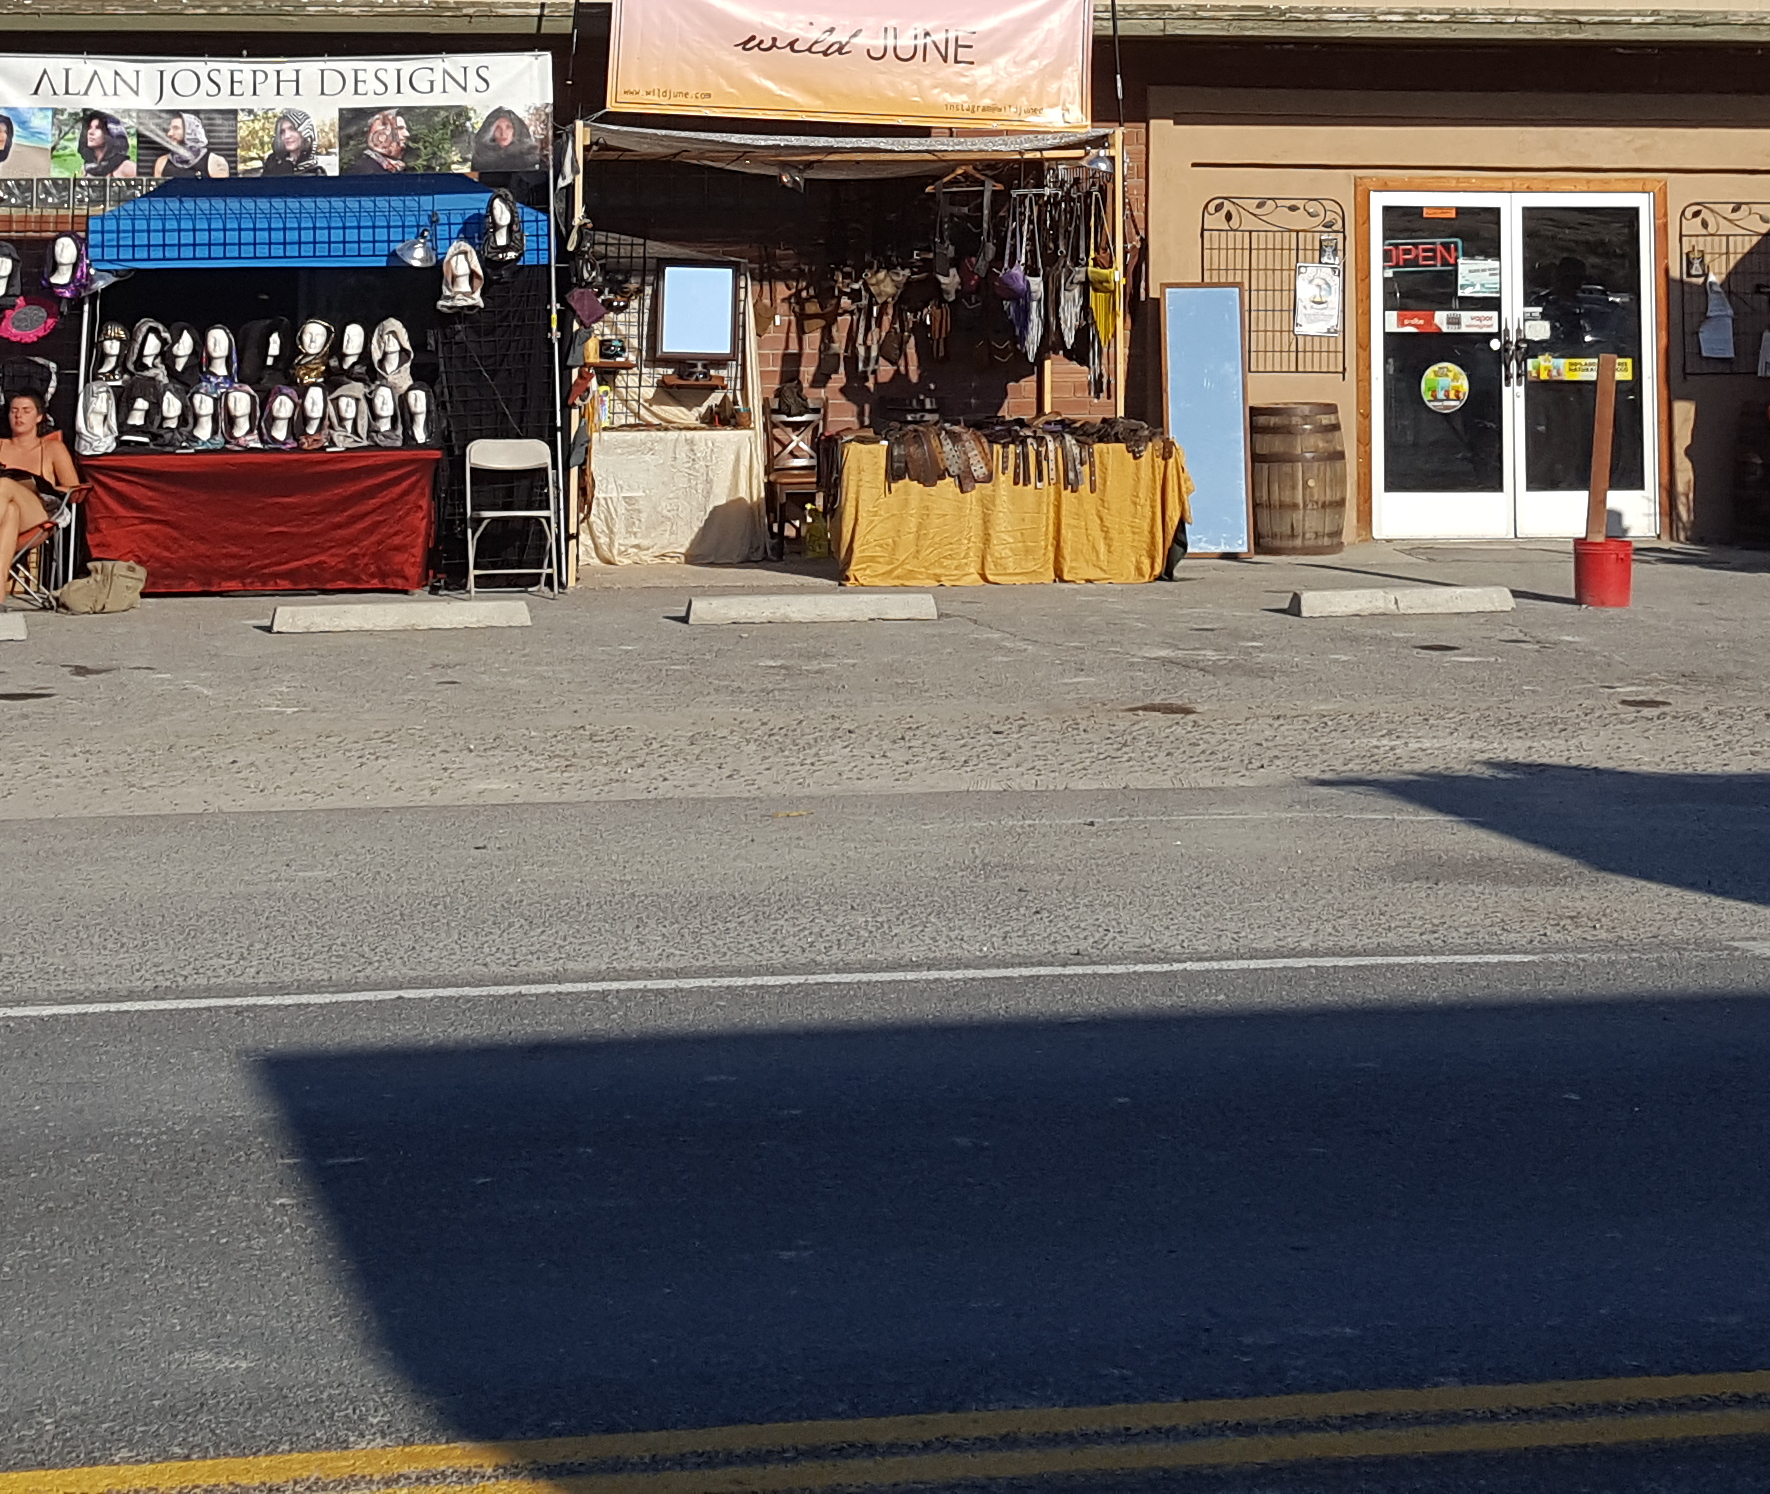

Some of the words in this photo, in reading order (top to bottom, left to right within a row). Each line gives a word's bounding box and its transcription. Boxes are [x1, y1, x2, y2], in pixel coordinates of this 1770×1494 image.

[733, 22, 864, 57] wild
[866, 26, 977, 66] JUNE
[29, 67, 141, 97] ALAN
[154, 68, 302, 106] JOSEPH
[317, 65, 492, 98] DESIGNS
[623, 88, 712, 100] www.wildjune.com
[1383, 243, 1457, 266] OPEN
